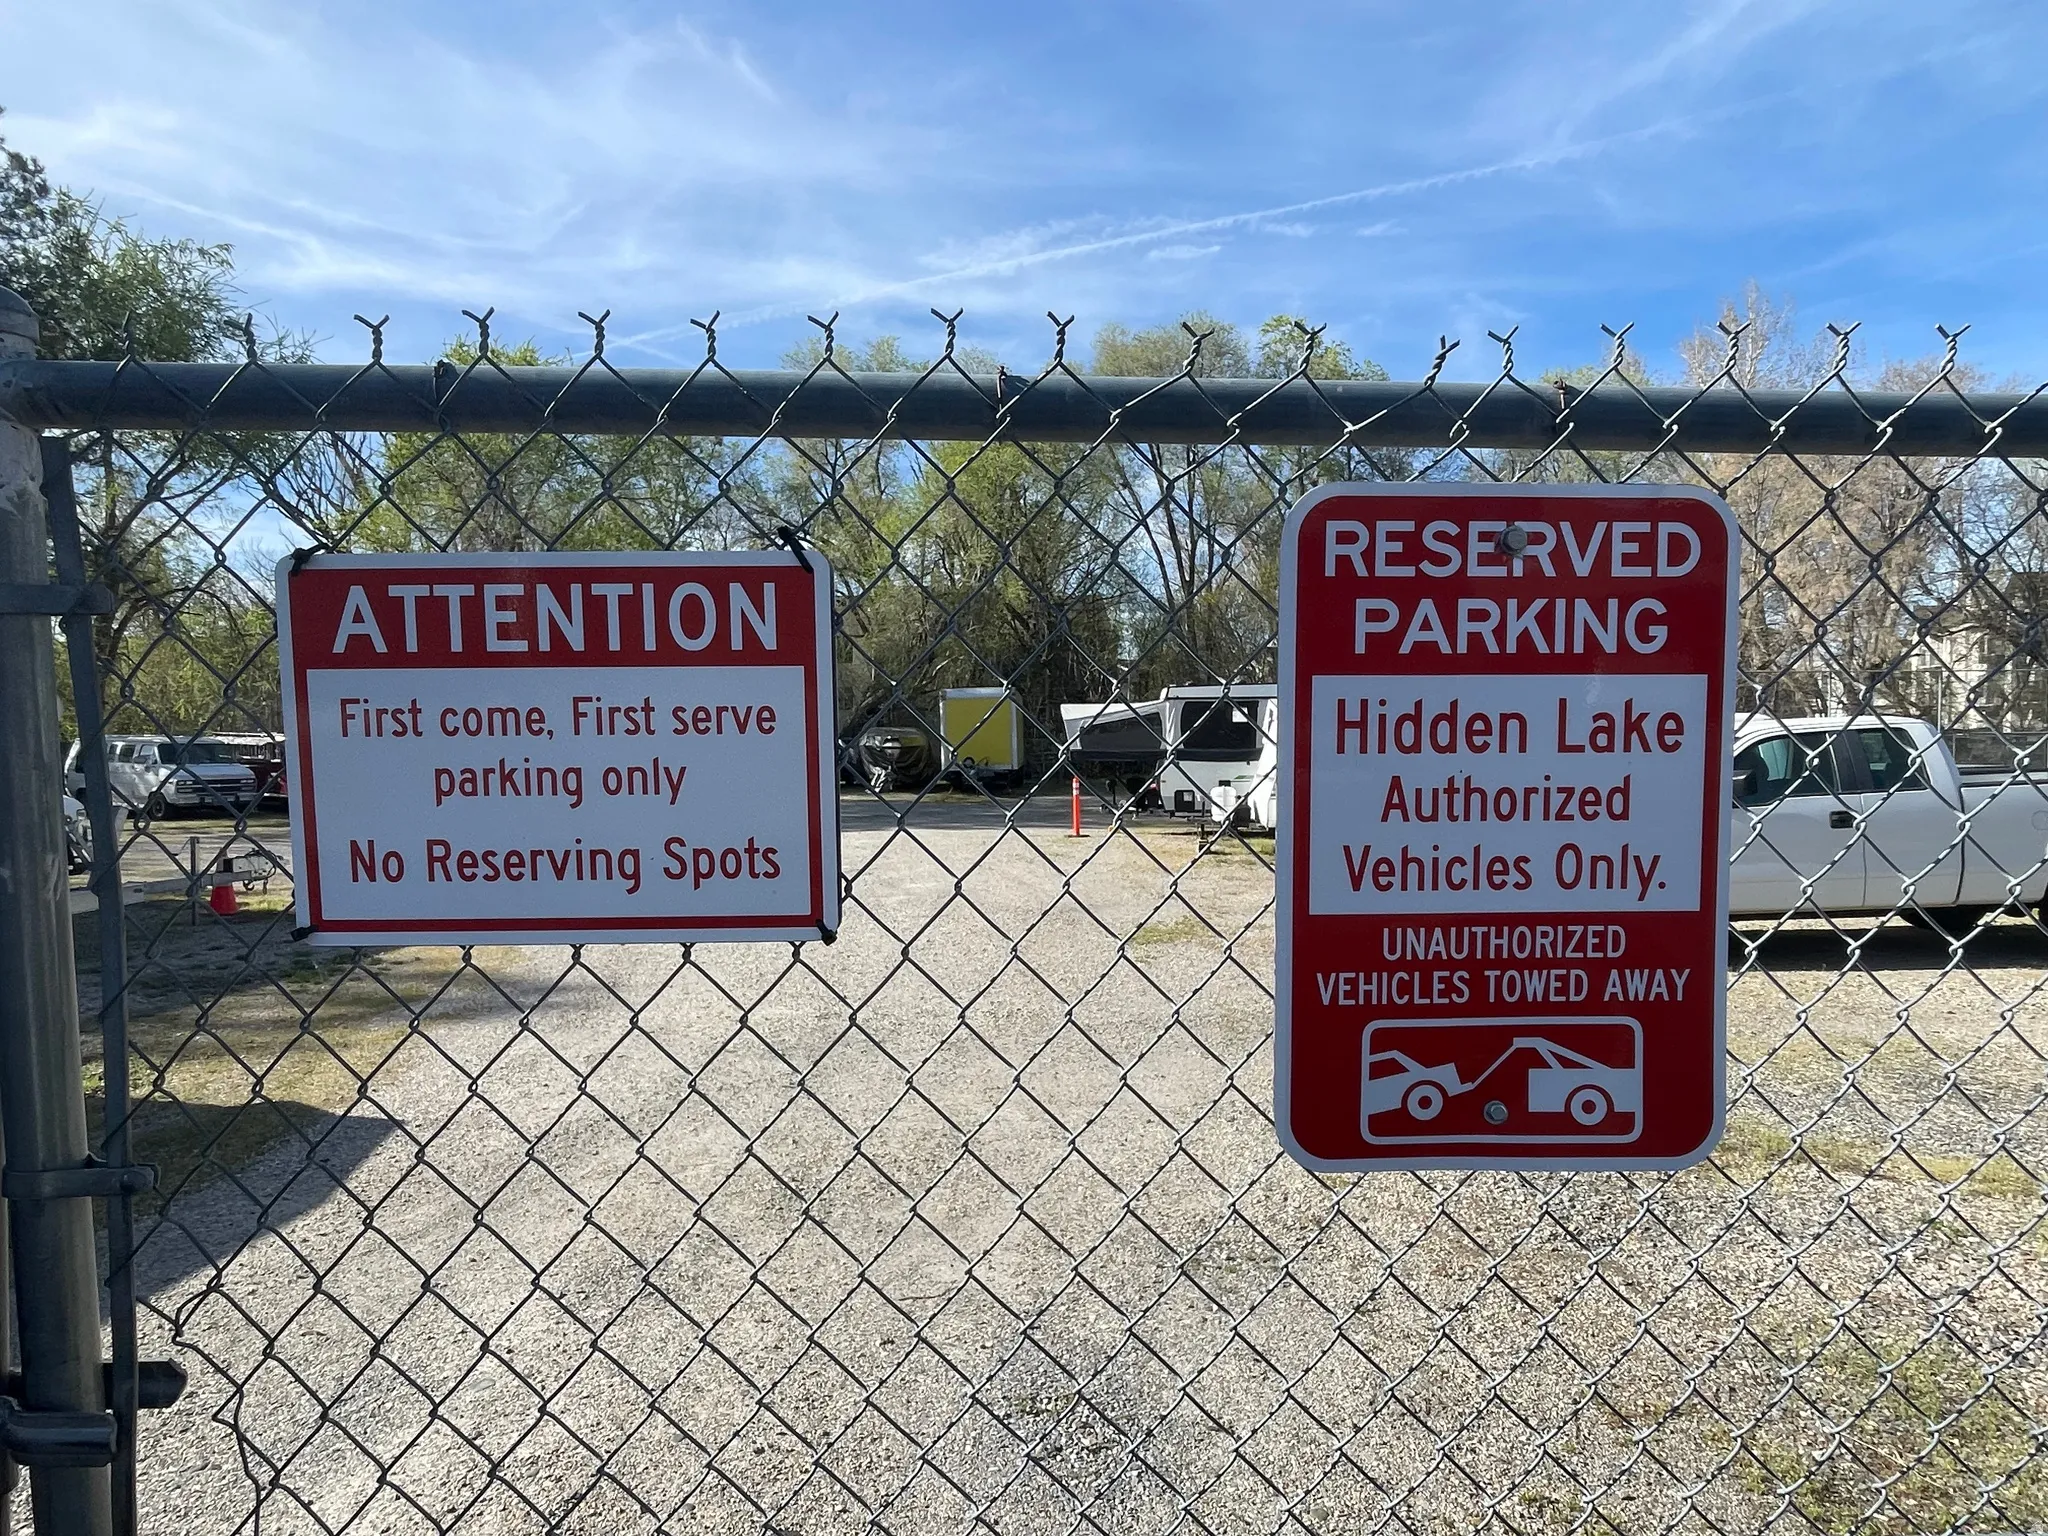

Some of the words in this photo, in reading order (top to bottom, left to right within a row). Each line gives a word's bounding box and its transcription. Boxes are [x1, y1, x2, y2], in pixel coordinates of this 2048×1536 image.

[1324, 520, 1701, 577] RESERVED
[332, 582, 778, 654] ATTENTION
[1354, 597, 1669, 655] PARKING
[340, 698, 423, 738] First
[439, 704, 554, 741] come,
[572, 696, 656, 736] First
[672, 704, 777, 735] serve
[1336, 698, 1527, 755] Hidden
[1557, 698, 1685, 754] Lake
[434, 757, 583, 809] parking
[602, 757, 687, 805] only
[1380, 774, 1631, 823] Authorized
[350, 839, 404, 883] No
[426, 838, 641, 894] Reserving
[663, 836, 782, 891] Spots
[1342, 843, 1533, 893] Vehicles
[1555, 842, 1667, 902] Only.
[1382, 924, 1626, 961] UNAUTHORIZED
[1316, 970, 1470, 1006] VEHICLES
[1484, 969, 1588, 1003] TOWED
[1604, 968, 1691, 1002] AWAY
